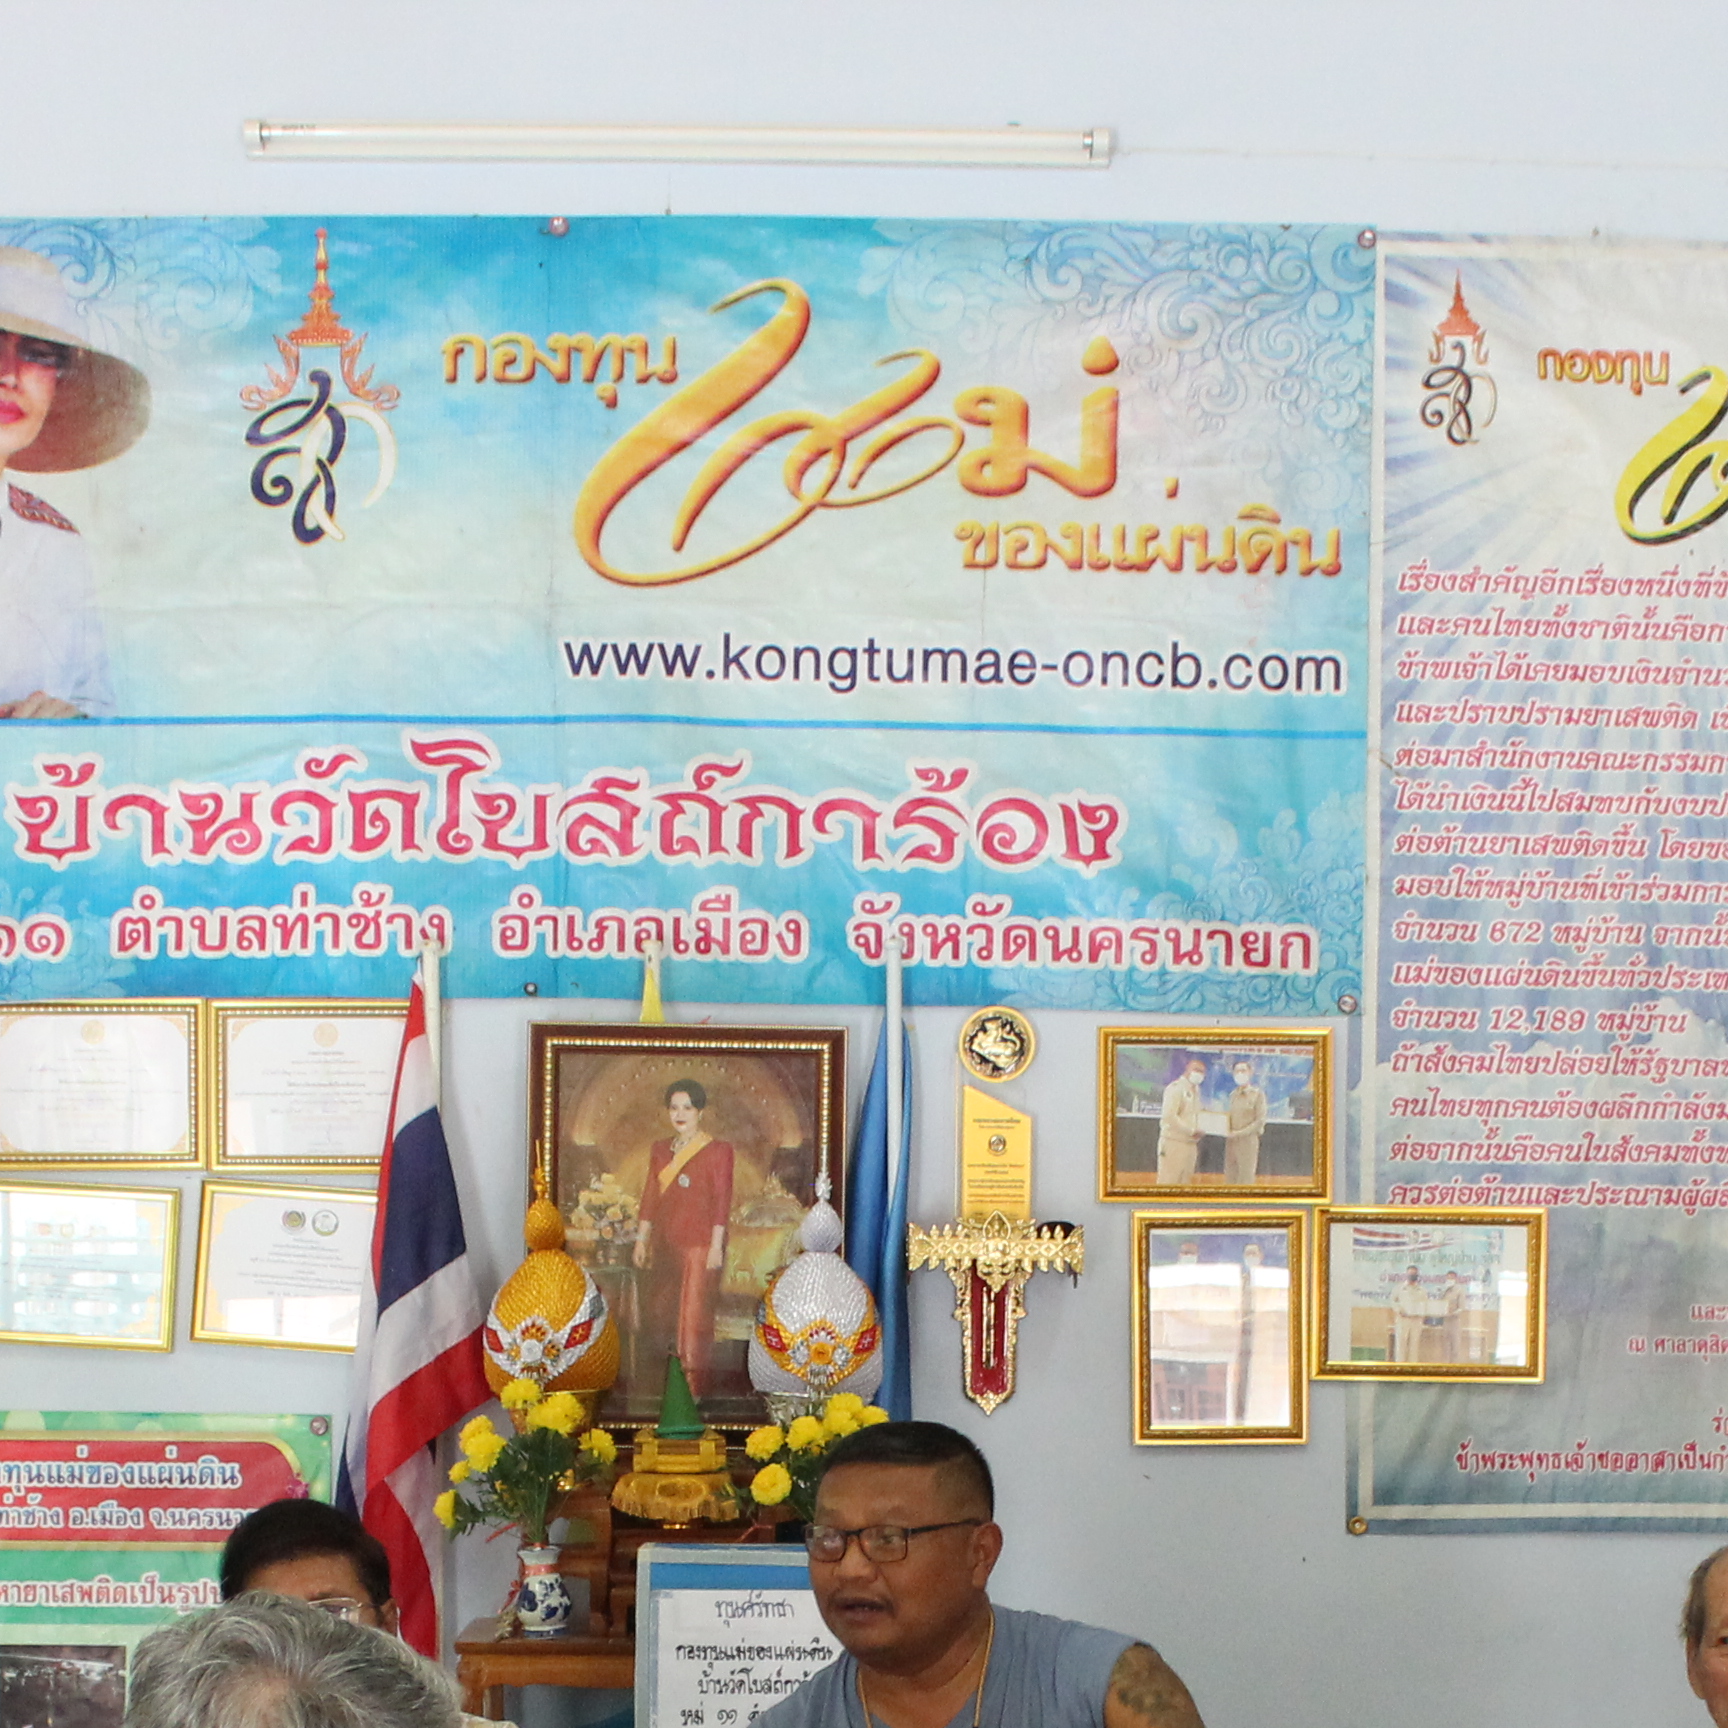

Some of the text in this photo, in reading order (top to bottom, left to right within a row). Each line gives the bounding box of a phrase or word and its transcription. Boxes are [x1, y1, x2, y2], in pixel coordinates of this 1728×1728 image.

[439, 333, 678, 420] กองทุน
[1538, 346, 1670, 396] กองทุน
[954, 483, 1344, 580] ของแผ่นดิน
[564, 634, 1346, 702] www.kongtumae-oncb.com
[1395, 697, 1699, 731] และปราบปรามยาเสพติด
[10, 738, 1124, 877] บ้านวัดโบสถ์การ้อง
[114, 893, 452, 964] ตำบลท่าช้าง
[495, 893, 809, 964] อำเภอเมือง
[1392, 911, 1479, 944] จำนวน
[1551, 914, 1645, 954] หมู่บ้าน
[1390, 999, 1689, 1042] จำนวน 12,189 หมู่บ้าน
[71, 1500, 144, 1529] อ.เมือง
